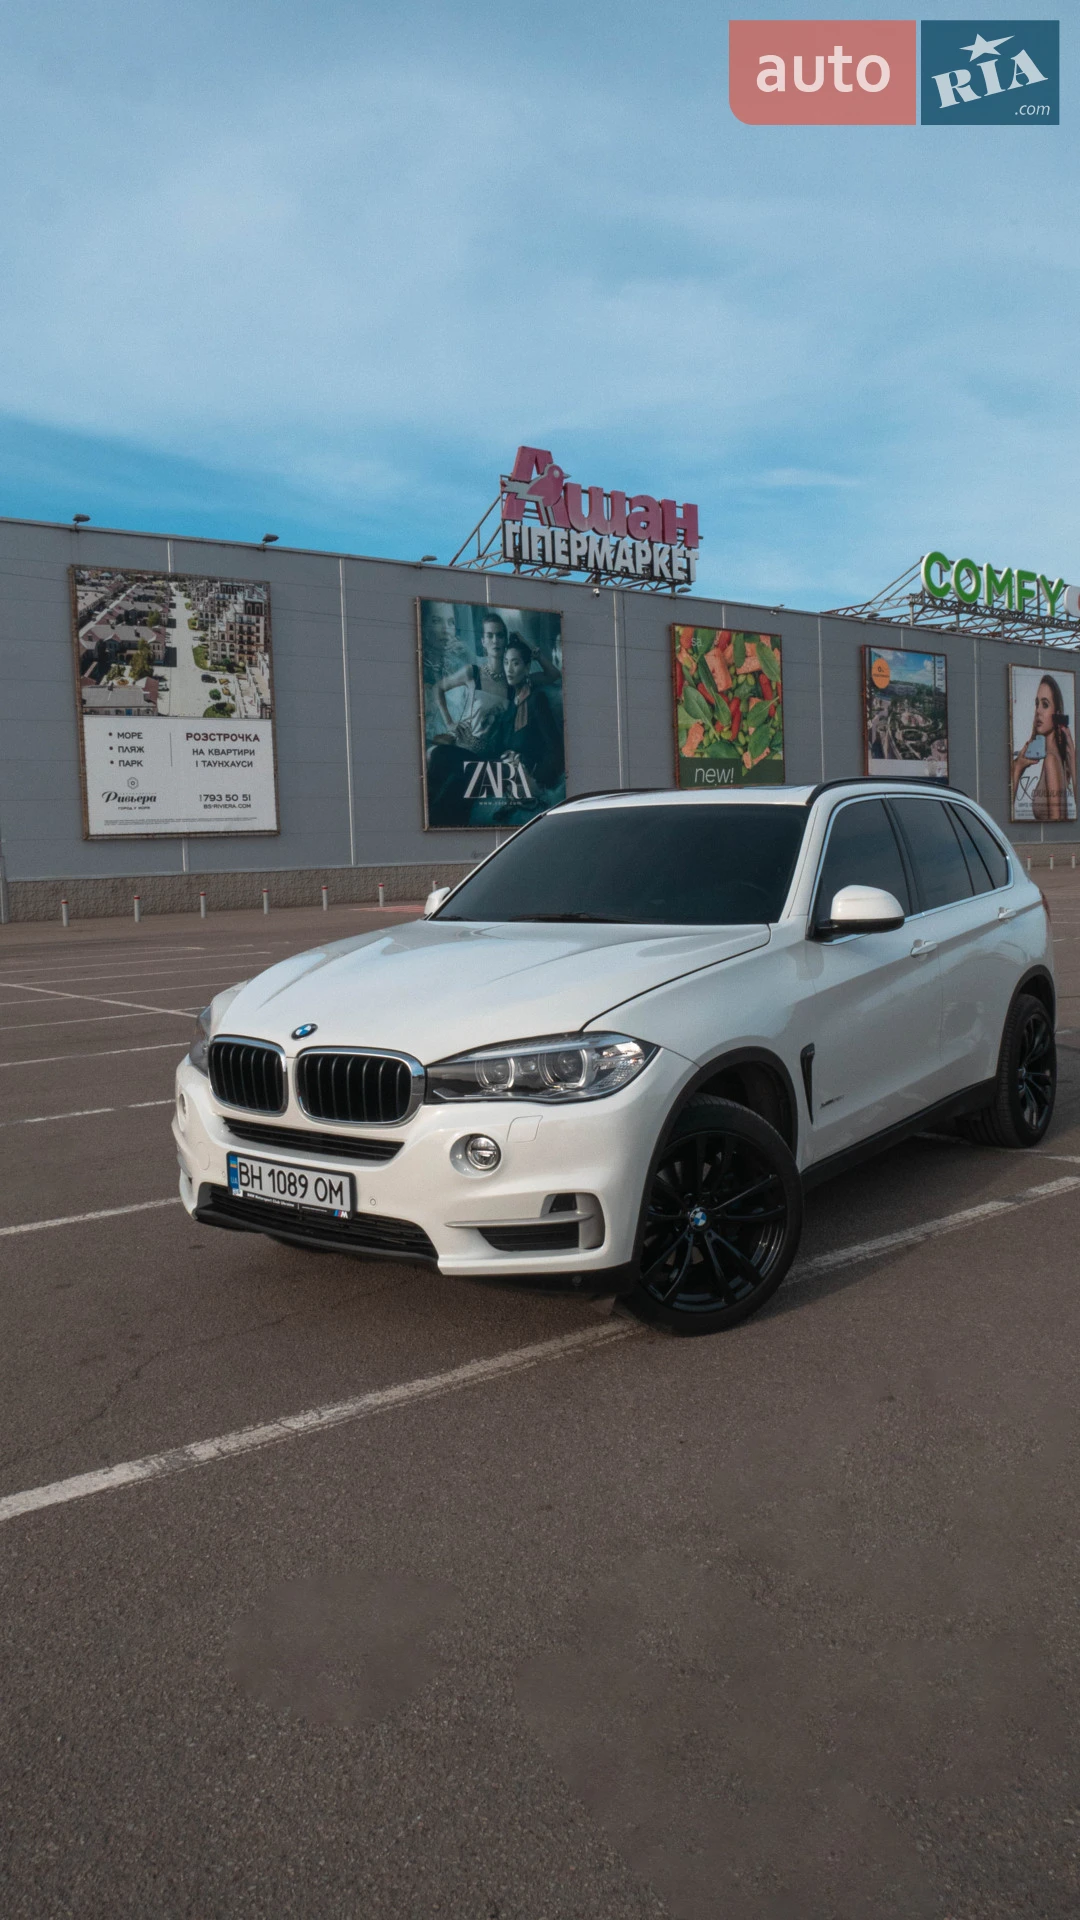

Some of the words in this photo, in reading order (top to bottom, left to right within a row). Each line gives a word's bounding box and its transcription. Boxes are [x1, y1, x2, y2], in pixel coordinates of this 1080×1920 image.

[502, 445, 699, 549] Ашан
[503, 523, 700, 584] ГІПЕРМАРКЕТ
[921, 551, 1065, 617] COMFY
[117, 731, 143, 740] МОРЕ
[186, 732, 260, 742] РОЗСТРОЧКА
[192, 748, 205, 756] НА
[208, 748, 255, 756] КВАРТИРИ
[118, 759, 144, 768] ПАРК
[201, 760, 253, 768] ТАУНХАУСИ
[463, 760, 536, 799] ZARA
[694, 767, 735, 784] new!
[101, 790, 157, 805] Ривьера
[225, 794, 239, 802] 50
[242, 794, 251, 802] 51
[239, 1162, 263, 1190] BH
[268, 1168, 308, 1199] 1089
[315, 1177, 343, 1206] OM
